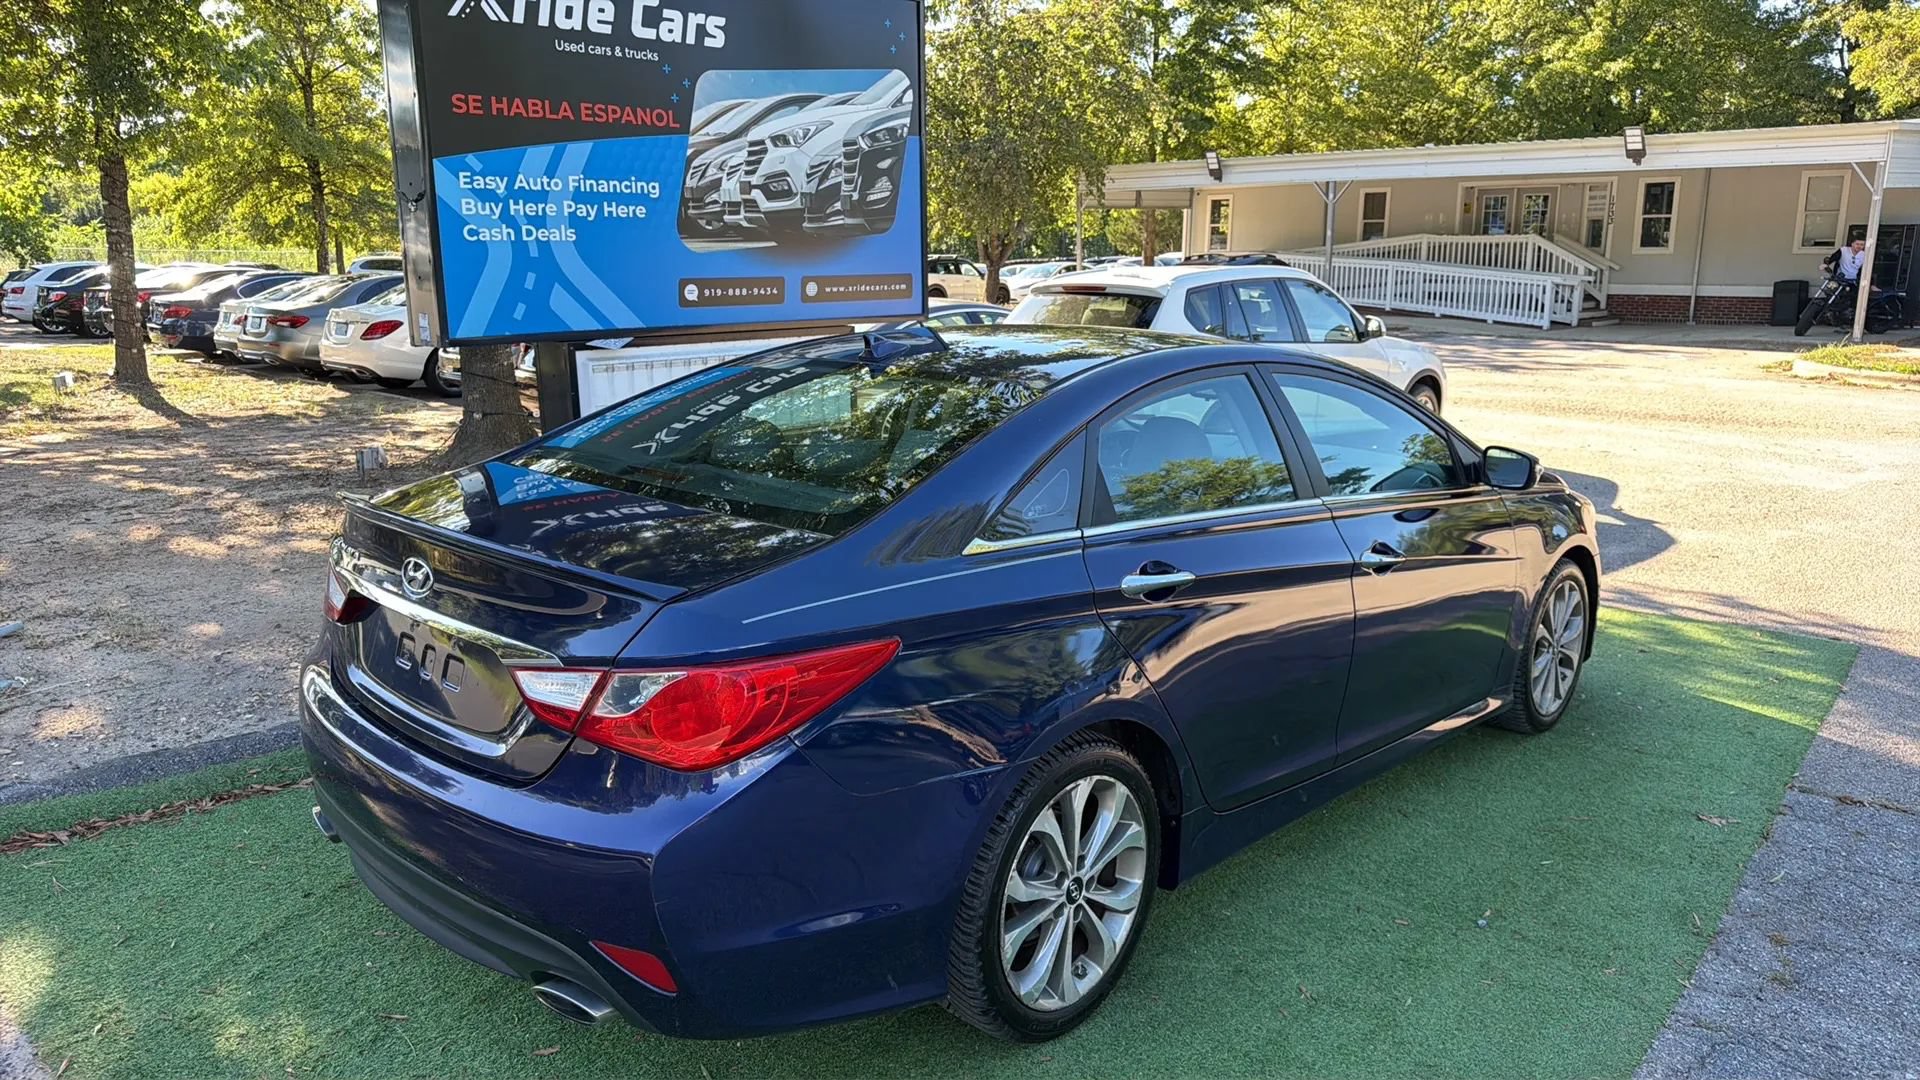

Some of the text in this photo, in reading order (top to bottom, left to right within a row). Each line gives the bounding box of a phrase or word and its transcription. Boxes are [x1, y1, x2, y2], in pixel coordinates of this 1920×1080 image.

[631, 0, 727, 49] Cars
[555, 39, 660, 62] Used cars & trucks
[451, 93, 681, 129] SE HABLA ESPANOL
[458, 171, 660, 198] Easy Auto Financing
[460, 198, 647, 221] Buy Here Pay Here
[463, 224, 577, 242] Cash Deals
[703, 287, 778, 297] 919-888-9434
[825, 284, 907, 293] www.xridecars.com
